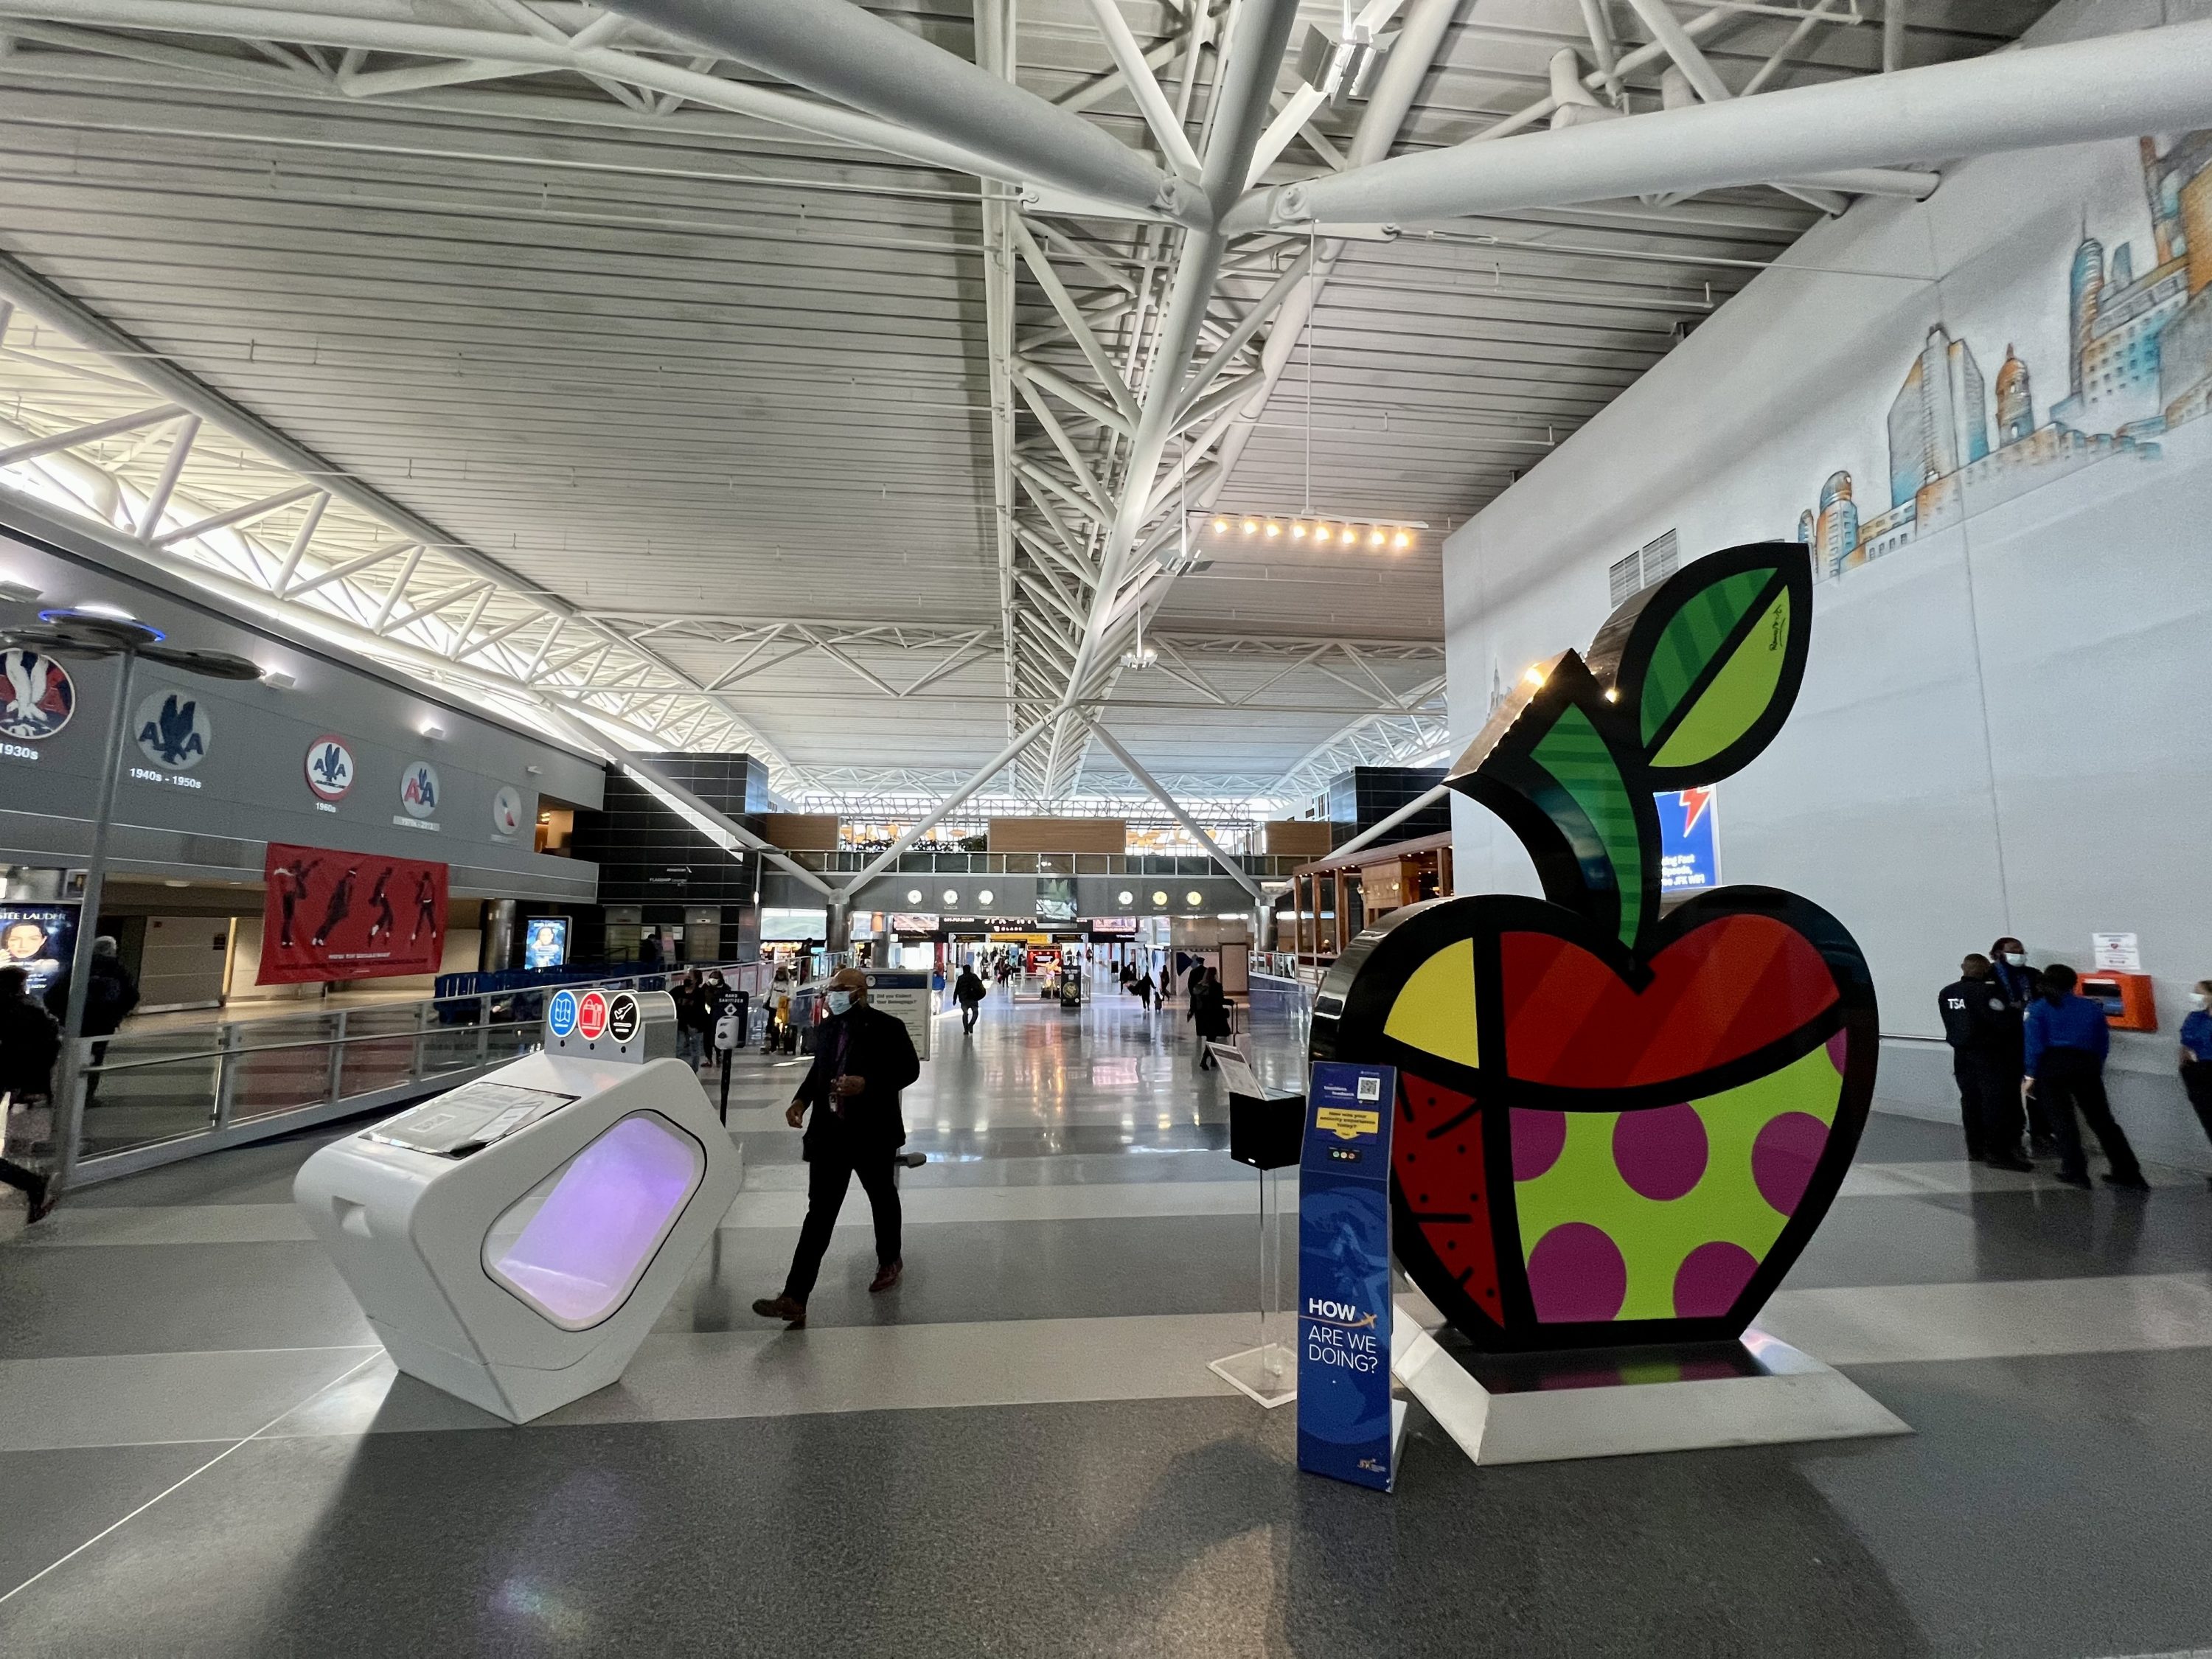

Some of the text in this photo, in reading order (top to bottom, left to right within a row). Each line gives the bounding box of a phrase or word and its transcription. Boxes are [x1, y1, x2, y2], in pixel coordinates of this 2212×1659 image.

[0, 742, 38, 760] 1930s
[130, 768, 162, 782] 1940s
[173, 776, 202, 789] 1950s
[316, 802, 336, 813] 1960s
[23, 913, 66, 921] LAUDER
[1947, 998, 1966, 1009] TSA
[1309, 1298, 1356, 1321] HOW
[1308, 1325, 1377, 1354] ARE WE
[1309, 1343, 1378, 1374] DOING?
